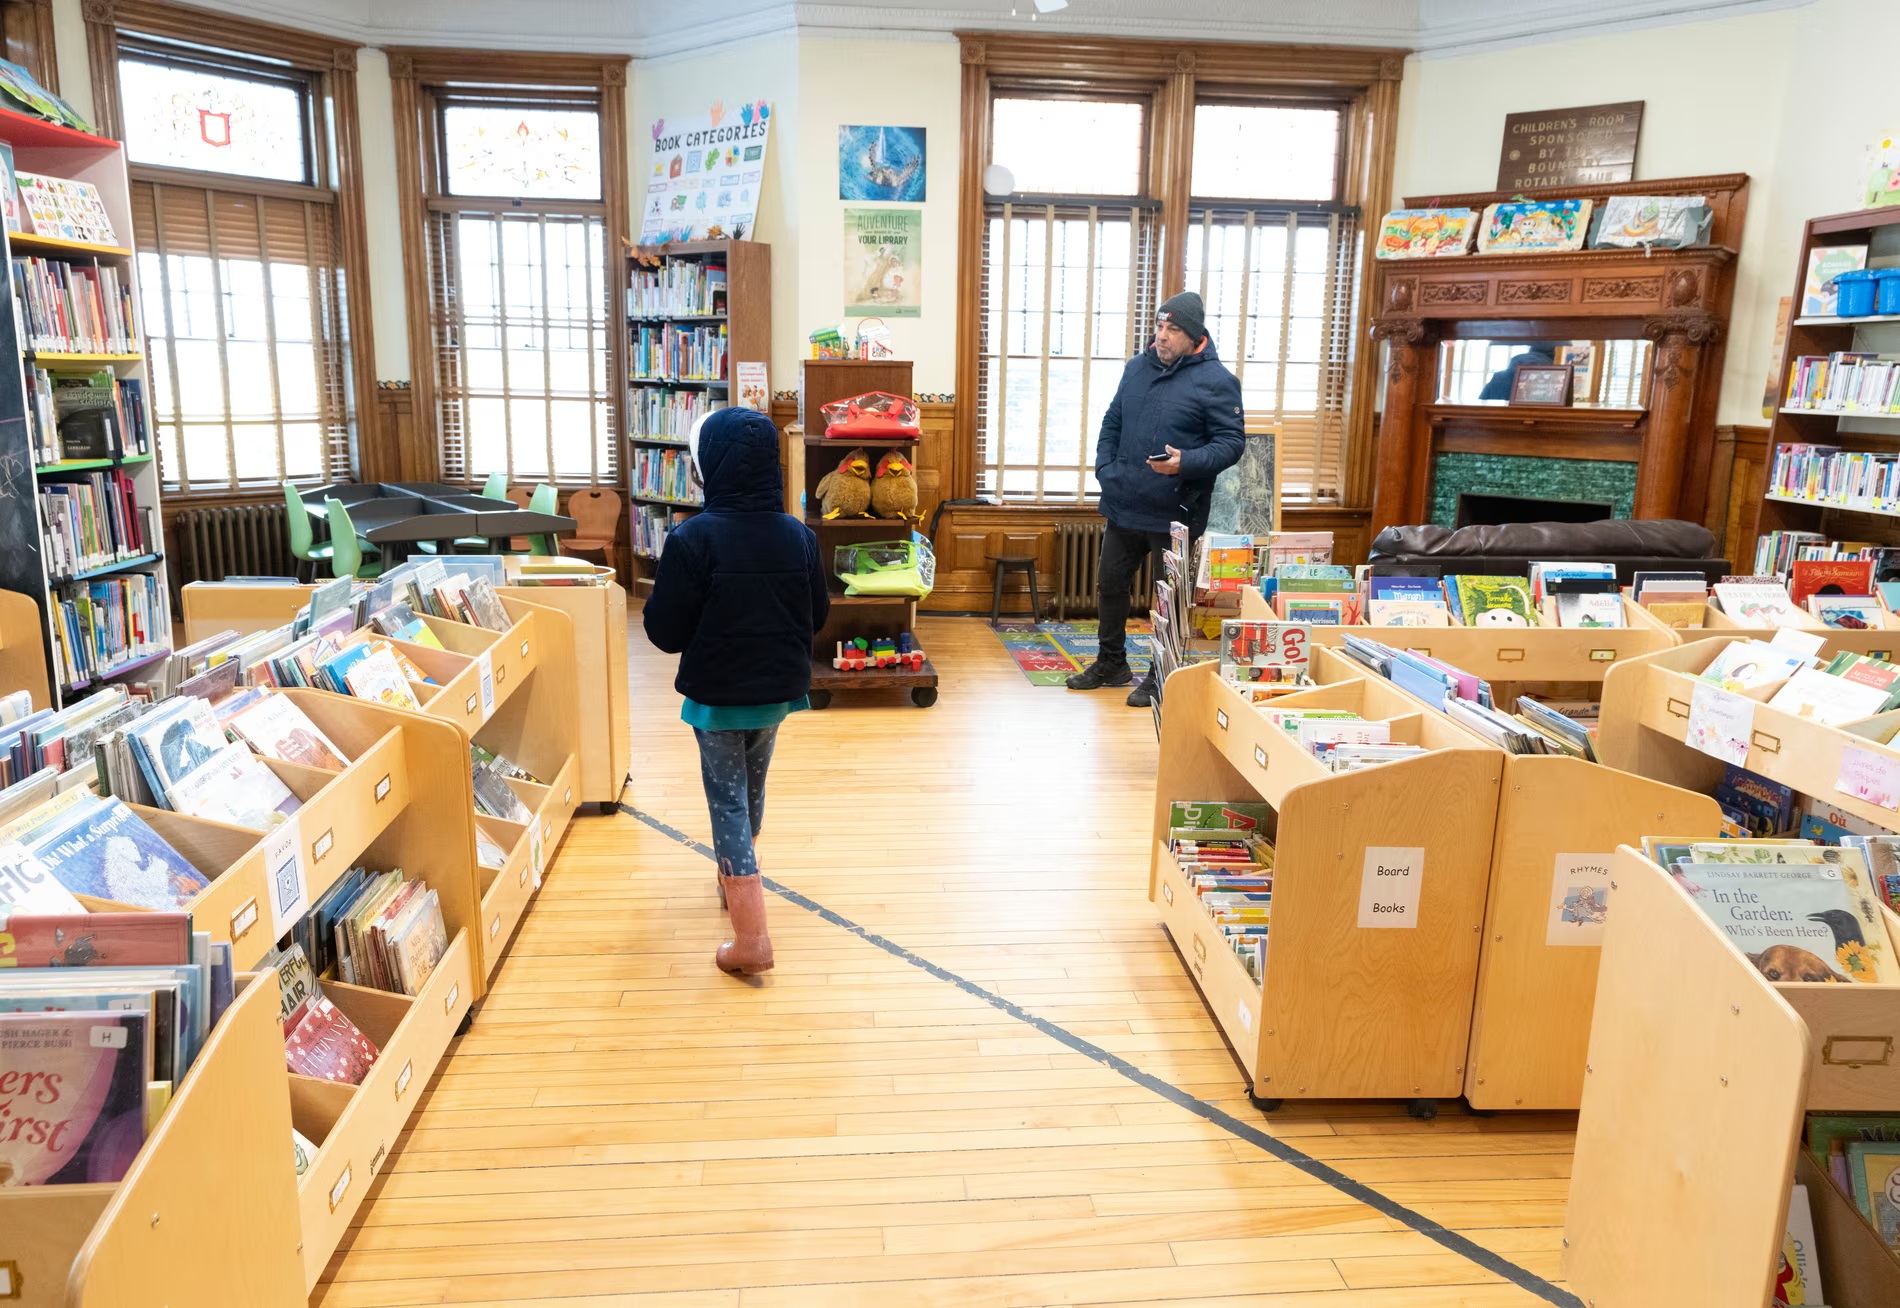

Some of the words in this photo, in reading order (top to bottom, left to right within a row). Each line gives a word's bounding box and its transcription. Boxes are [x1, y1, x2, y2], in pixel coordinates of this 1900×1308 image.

[1512, 117, 1577, 134] CHILDREN'S
[1589, 114, 1625, 126] ROOM
[654, 134, 681, 153] BOOK
[686, 121, 767, 147] CATEGORIES
[1539, 148, 1556, 159] BY
[1514, 176, 1566, 189] ROTARY
[857, 215, 909, 232] ADVENTURE
[858, 235, 877, 245] YOUR
[878, 235, 908, 245] LIBRARY
[1309, 568, 1318, 577] LE
[1282, 628, 1308, 666] Go!
[56, 833, 88, 860] What
[1377, 865, 1410, 876] Board
[1570, 864, 1608, 876] RHYMES
[1707, 870, 1742, 879] LINDSAY
[1743, 871, 1778, 879] BARRETT
[1780, 871, 1812, 879] GEORGE
[1827, 869, 1836, 878] G
[1713, 889, 1730, 903] In
[1734, 889, 1759, 903] the
[1372, 902, 1405, 913] Books
[1730, 906, 1793, 921] Garden:
[1725, 924, 1763, 937] Who's
[1766, 926, 1793, 937] Been
[1797, 926, 1829, 938] Here?
[22, 1028, 60, 1037] HAGER
[101, 1031, 112, 1043] H
[2, 1039, 41, 1049] PIERCE
[44, 1039, 72, 1048] BUSH
